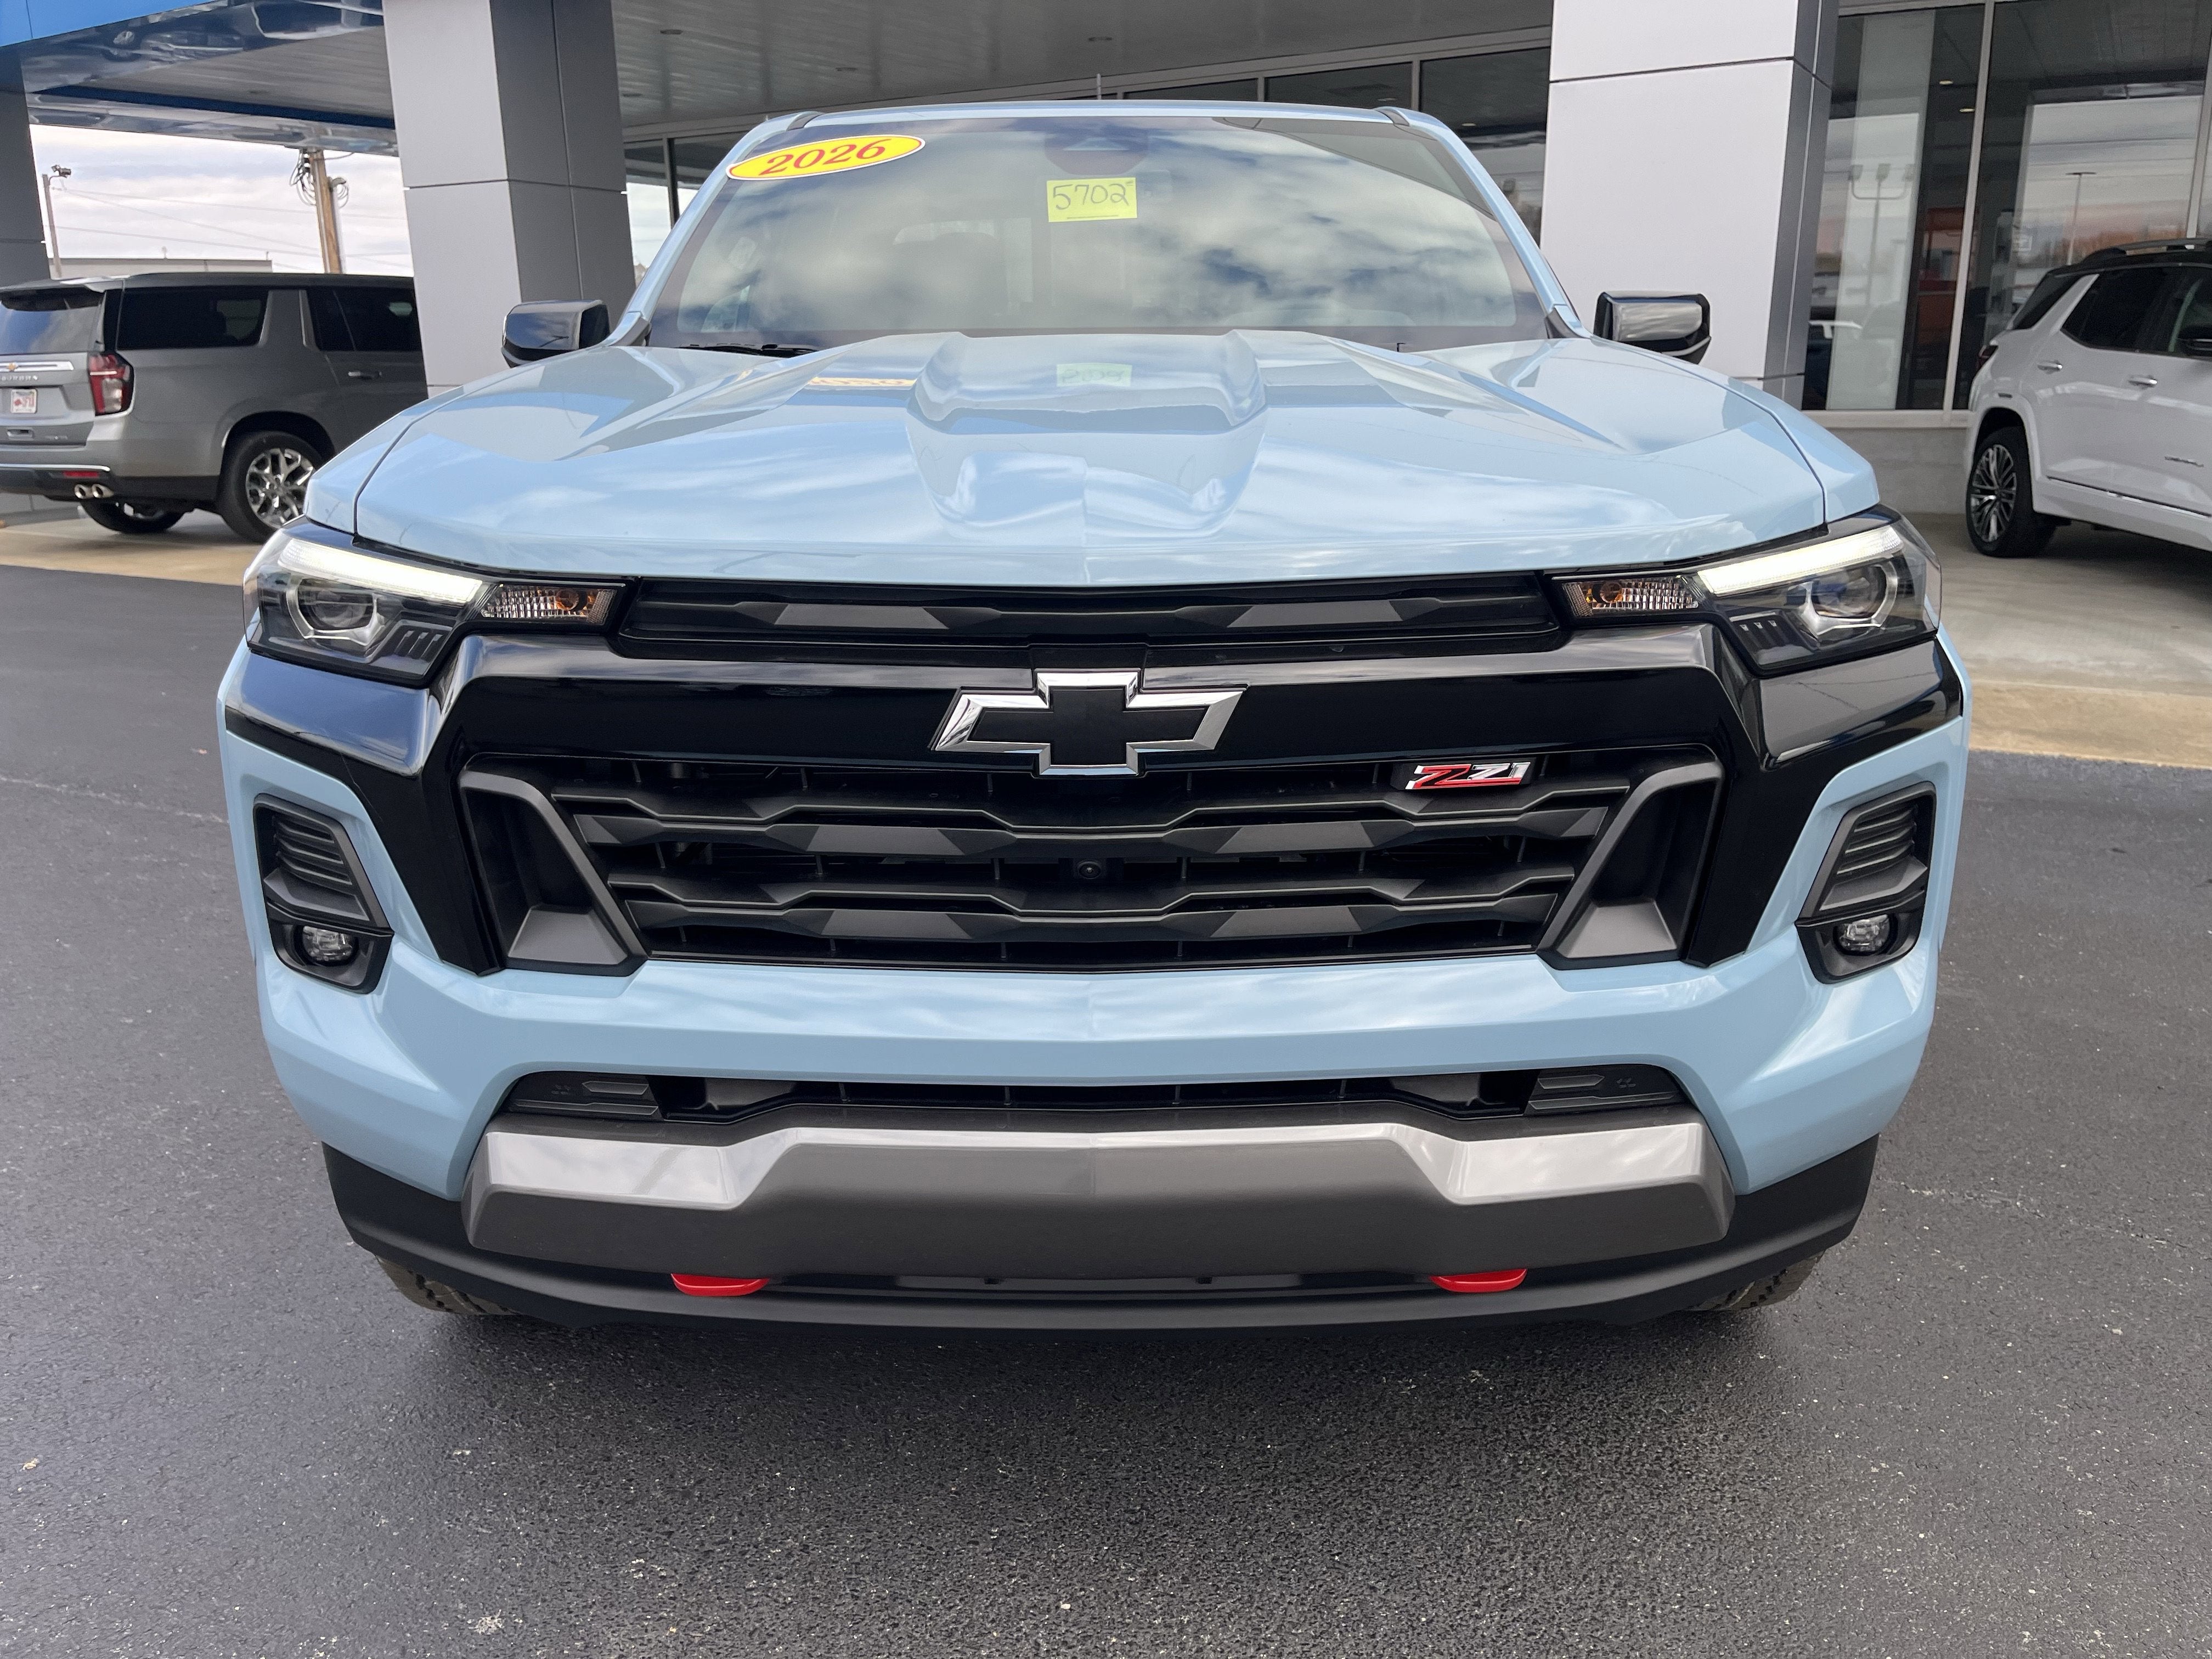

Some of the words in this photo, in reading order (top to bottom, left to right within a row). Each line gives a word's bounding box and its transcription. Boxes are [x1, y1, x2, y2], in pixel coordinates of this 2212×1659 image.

[758, 138, 892, 176] 2026
[1053, 183, 1130, 210] 5702
[1405, 761, 1531, 790] Z71
